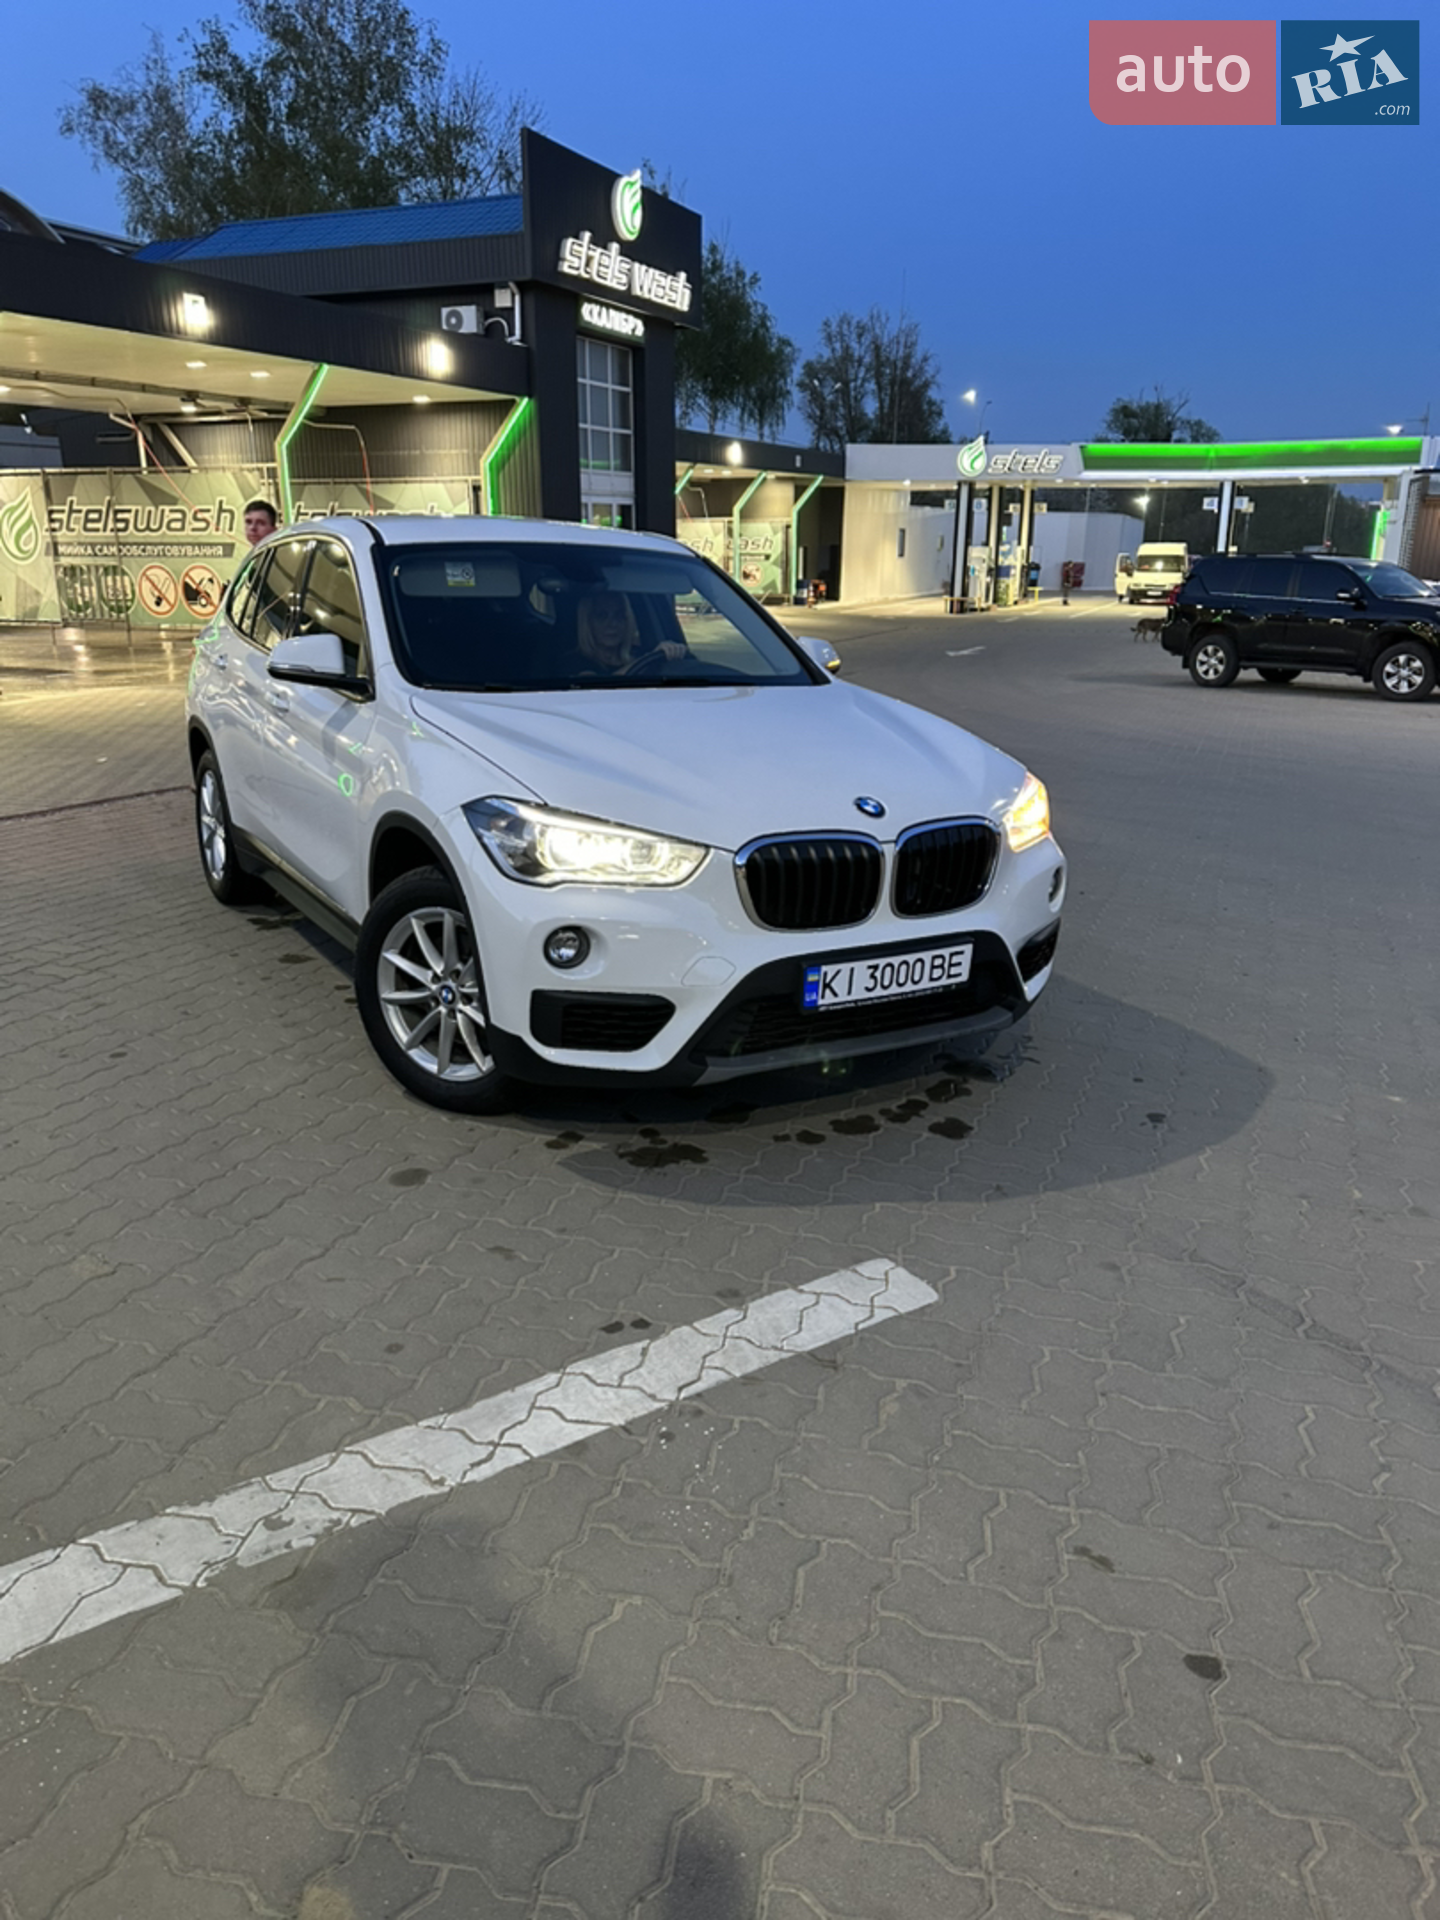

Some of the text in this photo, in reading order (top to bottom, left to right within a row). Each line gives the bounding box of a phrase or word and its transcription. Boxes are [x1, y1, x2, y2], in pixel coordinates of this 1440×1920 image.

[557, 230, 632, 291] stels
[988, 449, 1063, 474] stels
[46, 498, 235, 534] stelswash
[58, 543, 93, 557] МИЙКА
